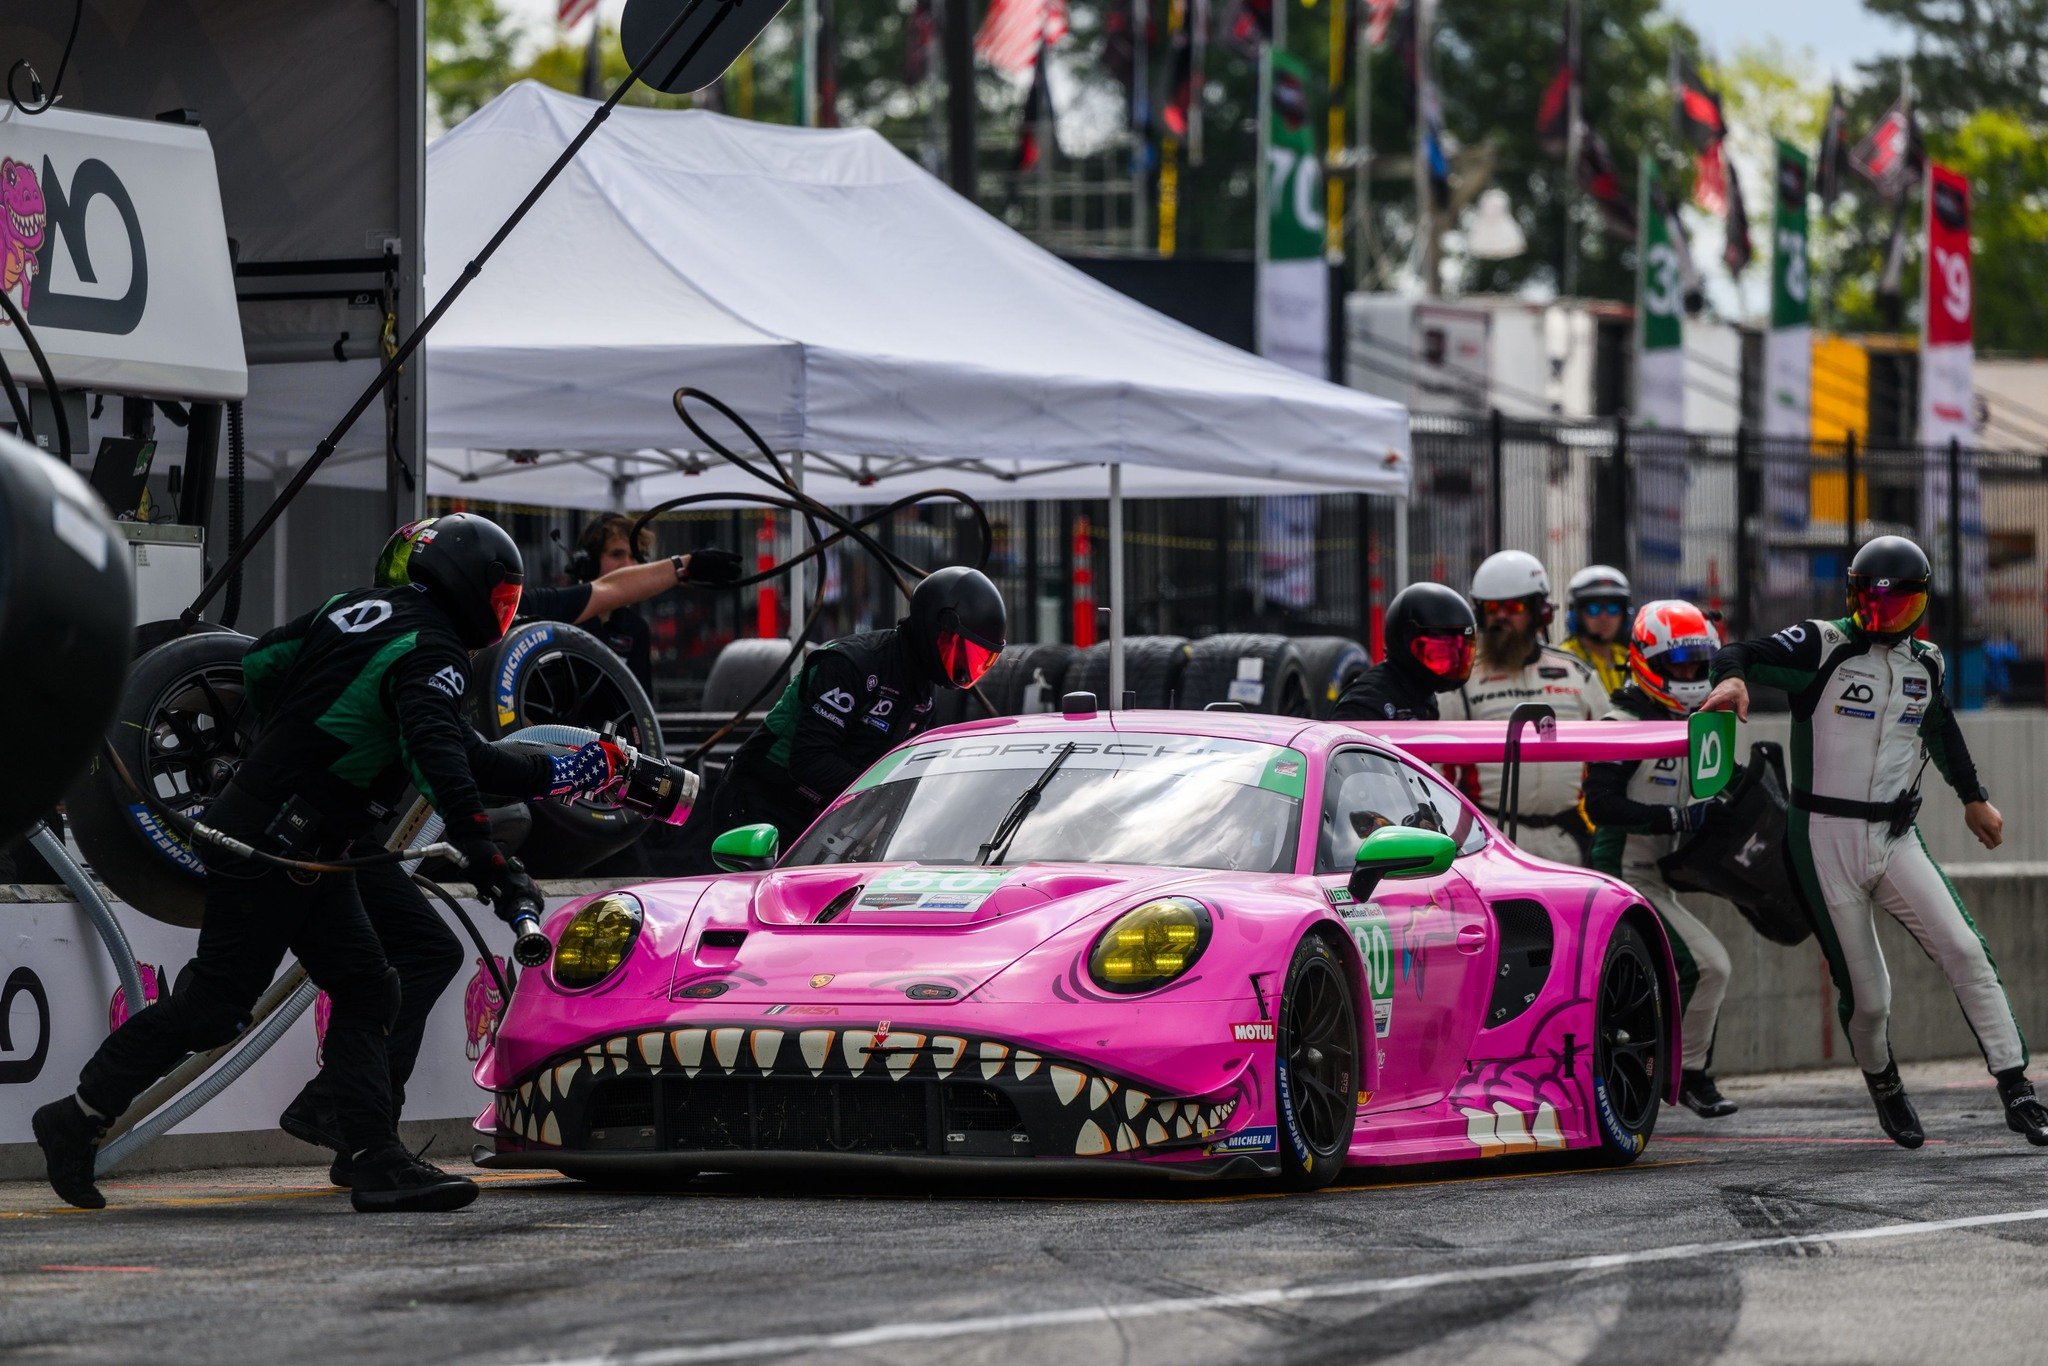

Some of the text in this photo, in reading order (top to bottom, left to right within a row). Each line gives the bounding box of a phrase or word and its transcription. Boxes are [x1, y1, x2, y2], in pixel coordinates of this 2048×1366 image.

[502, 629, 549, 695] MICHELIN
[1334, 889, 1352, 901] GTD
[1338, 905, 1382, 919] WeatherTech
[1355, 925, 1389, 995] 80
[788, 1007, 839, 1016] IMSA
[879, 1021, 890, 1036] TOW
[1234, 1024, 1274, 1041] MOTUL
[1279, 1066, 1307, 1150] MICHELIN
[1598, 1086, 1634, 1154] MICHELIN
[1228, 1134, 1272, 1147] MICHELIN
